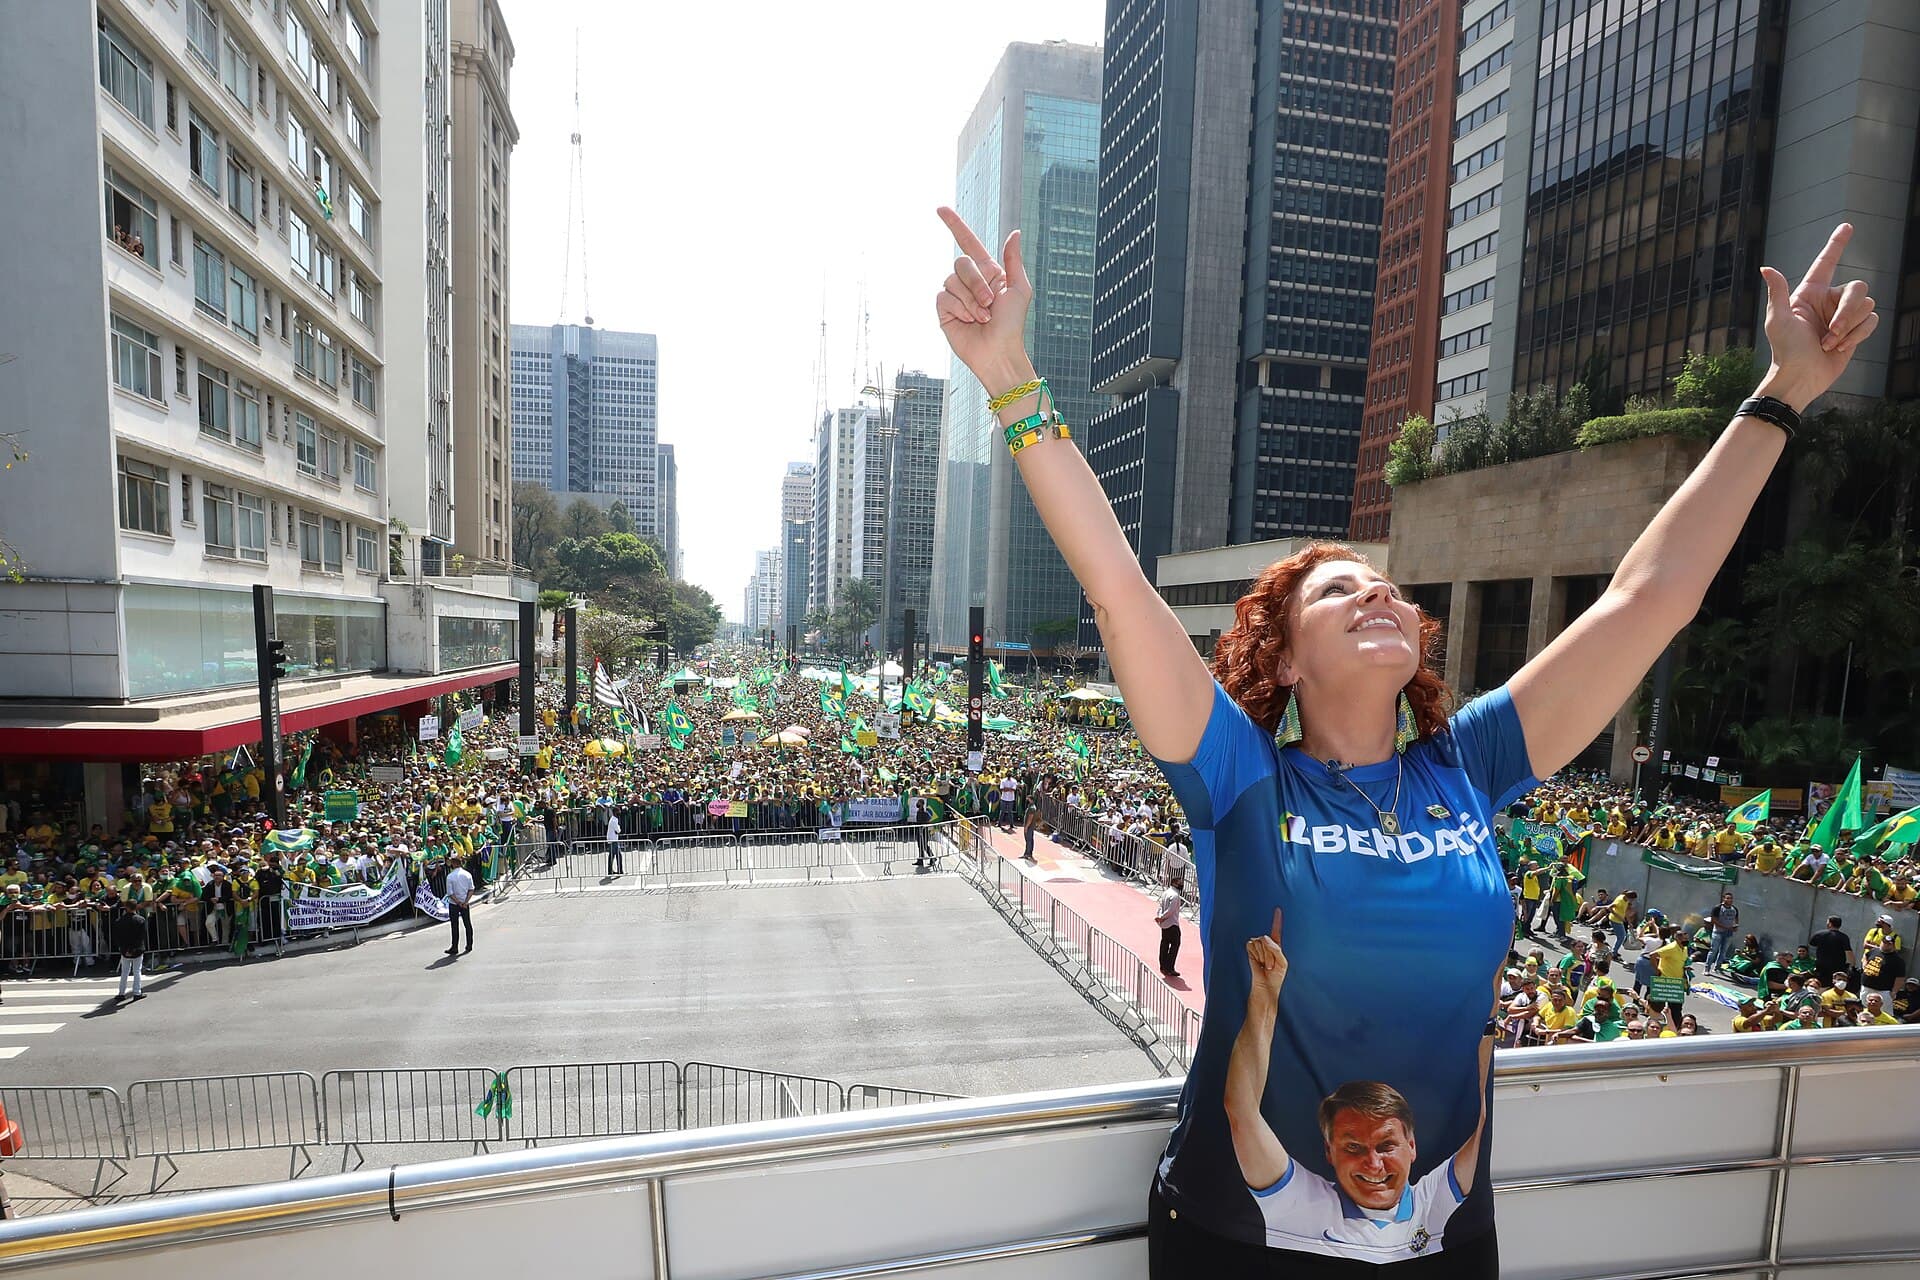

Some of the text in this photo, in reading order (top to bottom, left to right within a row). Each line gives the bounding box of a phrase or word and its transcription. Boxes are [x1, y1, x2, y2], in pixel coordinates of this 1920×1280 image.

[1649, 698, 1661, 737] Paulista
[290, 908, 301, 916] WE
[288, 917, 322, 927] QUEREMOS
[323, 916, 331, 924] LA
